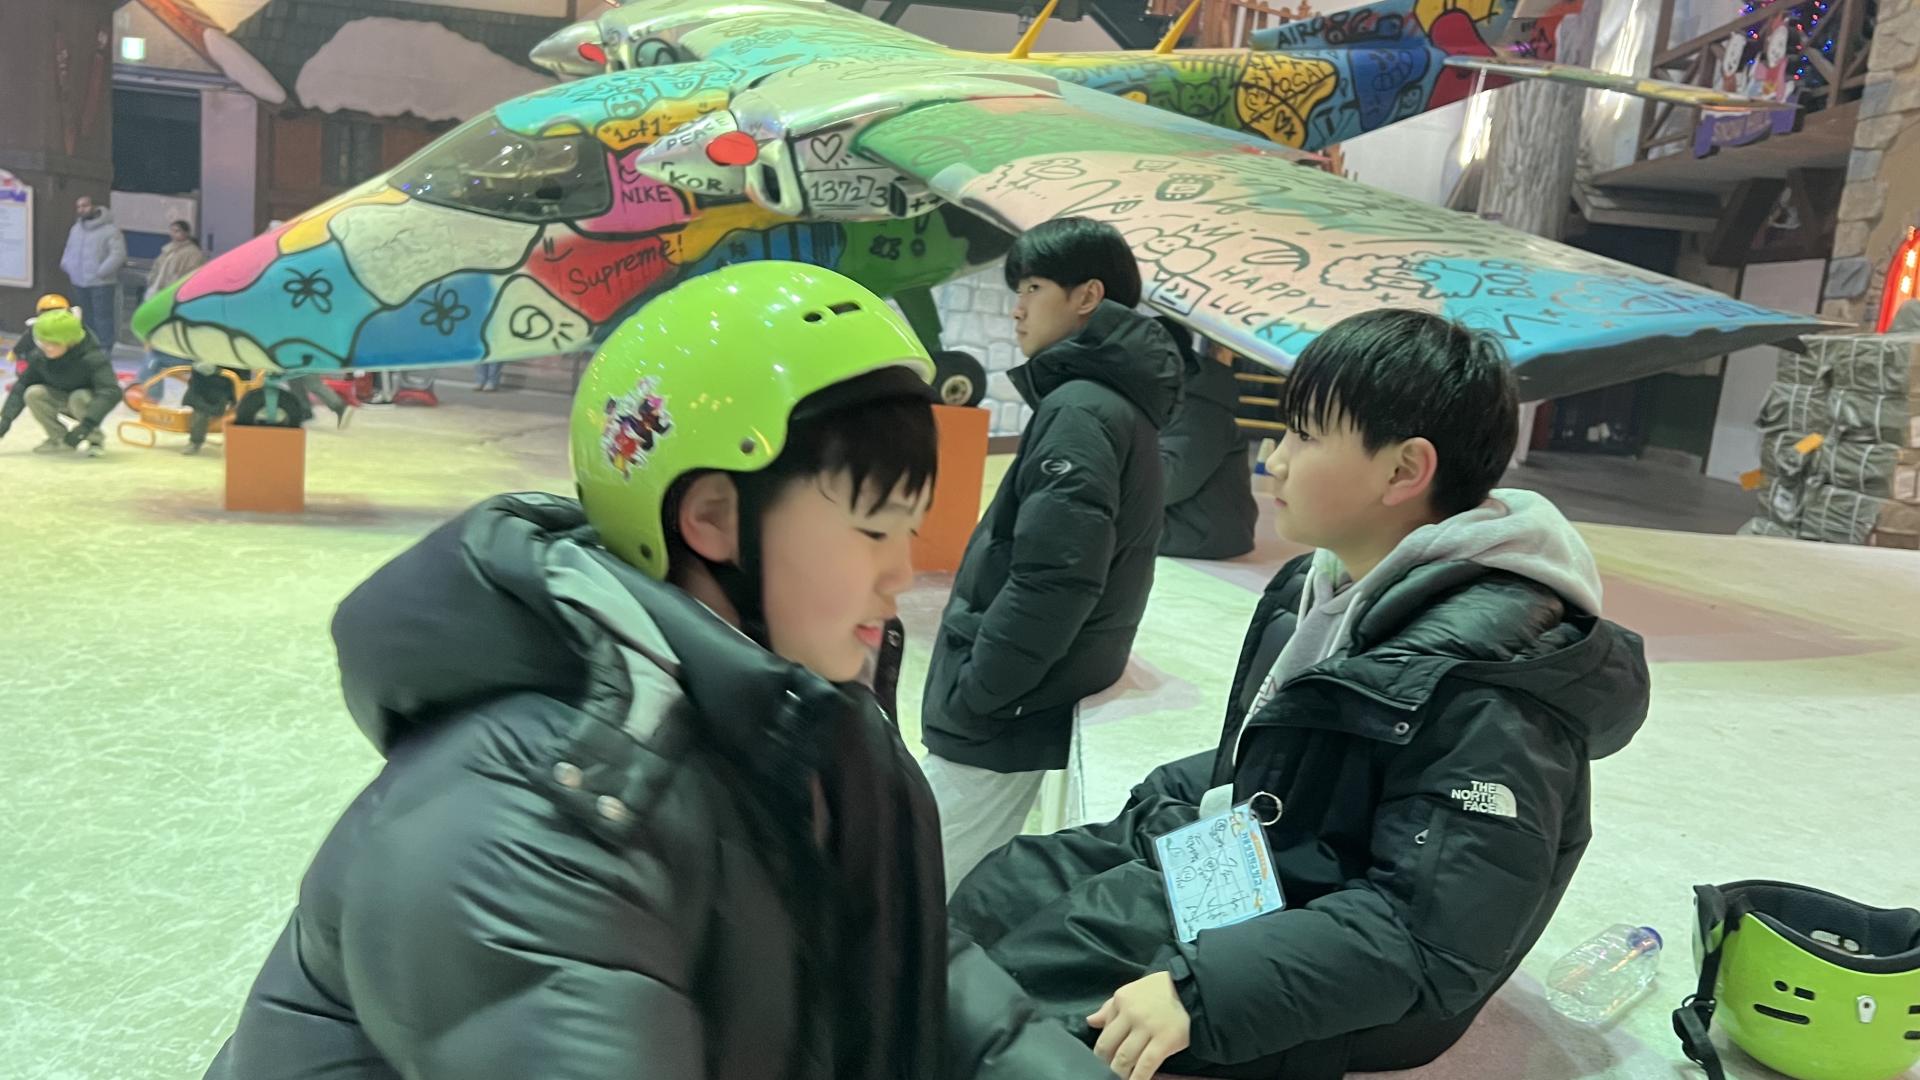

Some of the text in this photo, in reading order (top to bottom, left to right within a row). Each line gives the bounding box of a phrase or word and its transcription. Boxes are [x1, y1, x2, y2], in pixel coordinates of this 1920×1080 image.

[621, 186, 672, 205] NIKE
[568, 234, 684, 296] Supreme!
[1210, 265, 1332, 315] HAPPY
[1208, 293, 1322, 344] LUCKY
[1451, 788, 1496, 803] NORTH
[1471, 780, 1497, 794] THE
[1463, 800, 1497, 814] FACE
